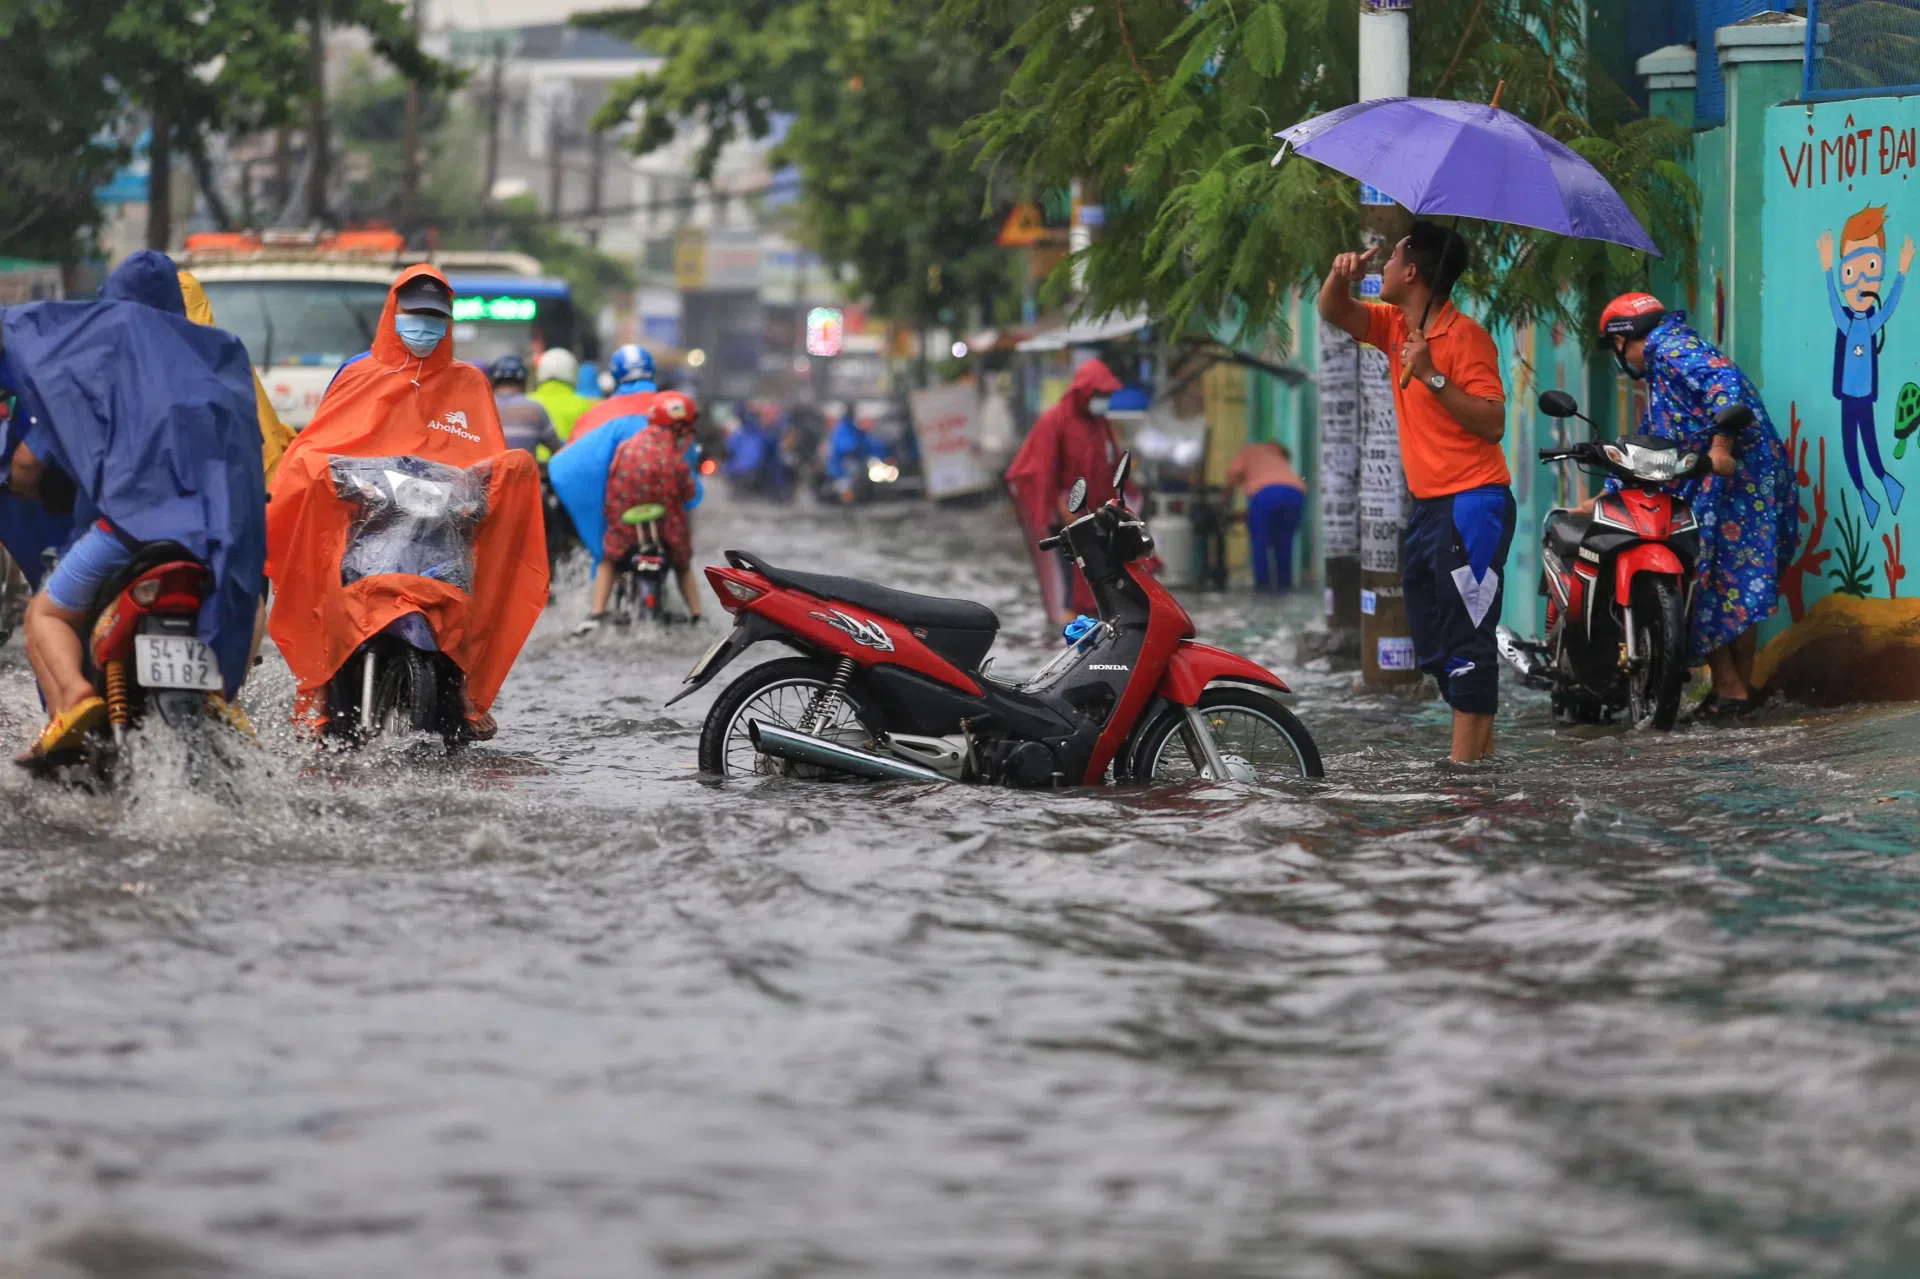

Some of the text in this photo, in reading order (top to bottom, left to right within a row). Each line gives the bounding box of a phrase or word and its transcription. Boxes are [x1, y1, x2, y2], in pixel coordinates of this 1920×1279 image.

[1821, 113, 1873, 191] MỘT
[1879, 125, 1917, 180] ĐẠI
[427, 420, 481, 443] AhaMove
[150, 639, 208, 662] 54-V2
[151, 662, 209, 686] 6182
